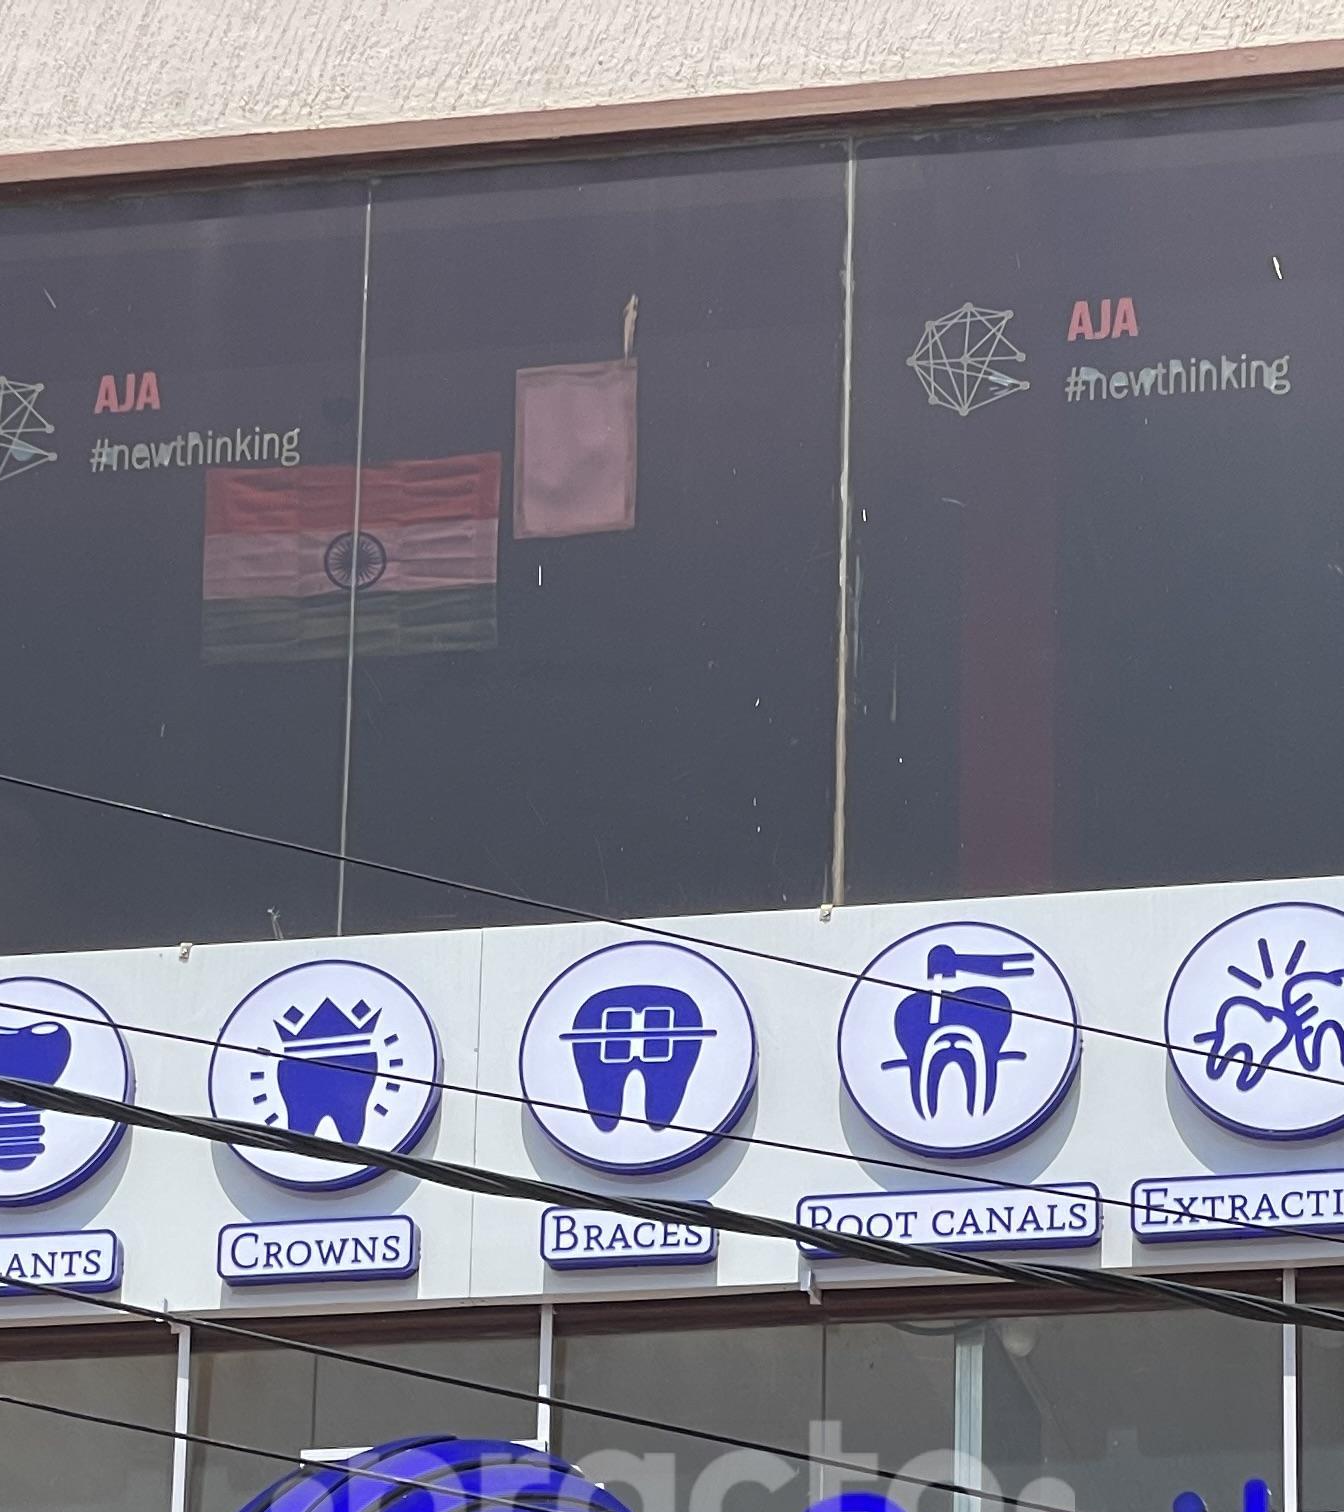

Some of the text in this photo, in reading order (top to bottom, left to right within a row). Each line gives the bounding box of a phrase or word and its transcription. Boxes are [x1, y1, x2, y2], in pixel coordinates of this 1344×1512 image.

[1067, 297, 1138, 341] AJA
[94, 371, 160, 414] AJA
[1064, 353, 1291, 402] #newthinking
[90, 426, 301, 472] #newthinking
[230, 1233, 400, 1270] CROWNS
